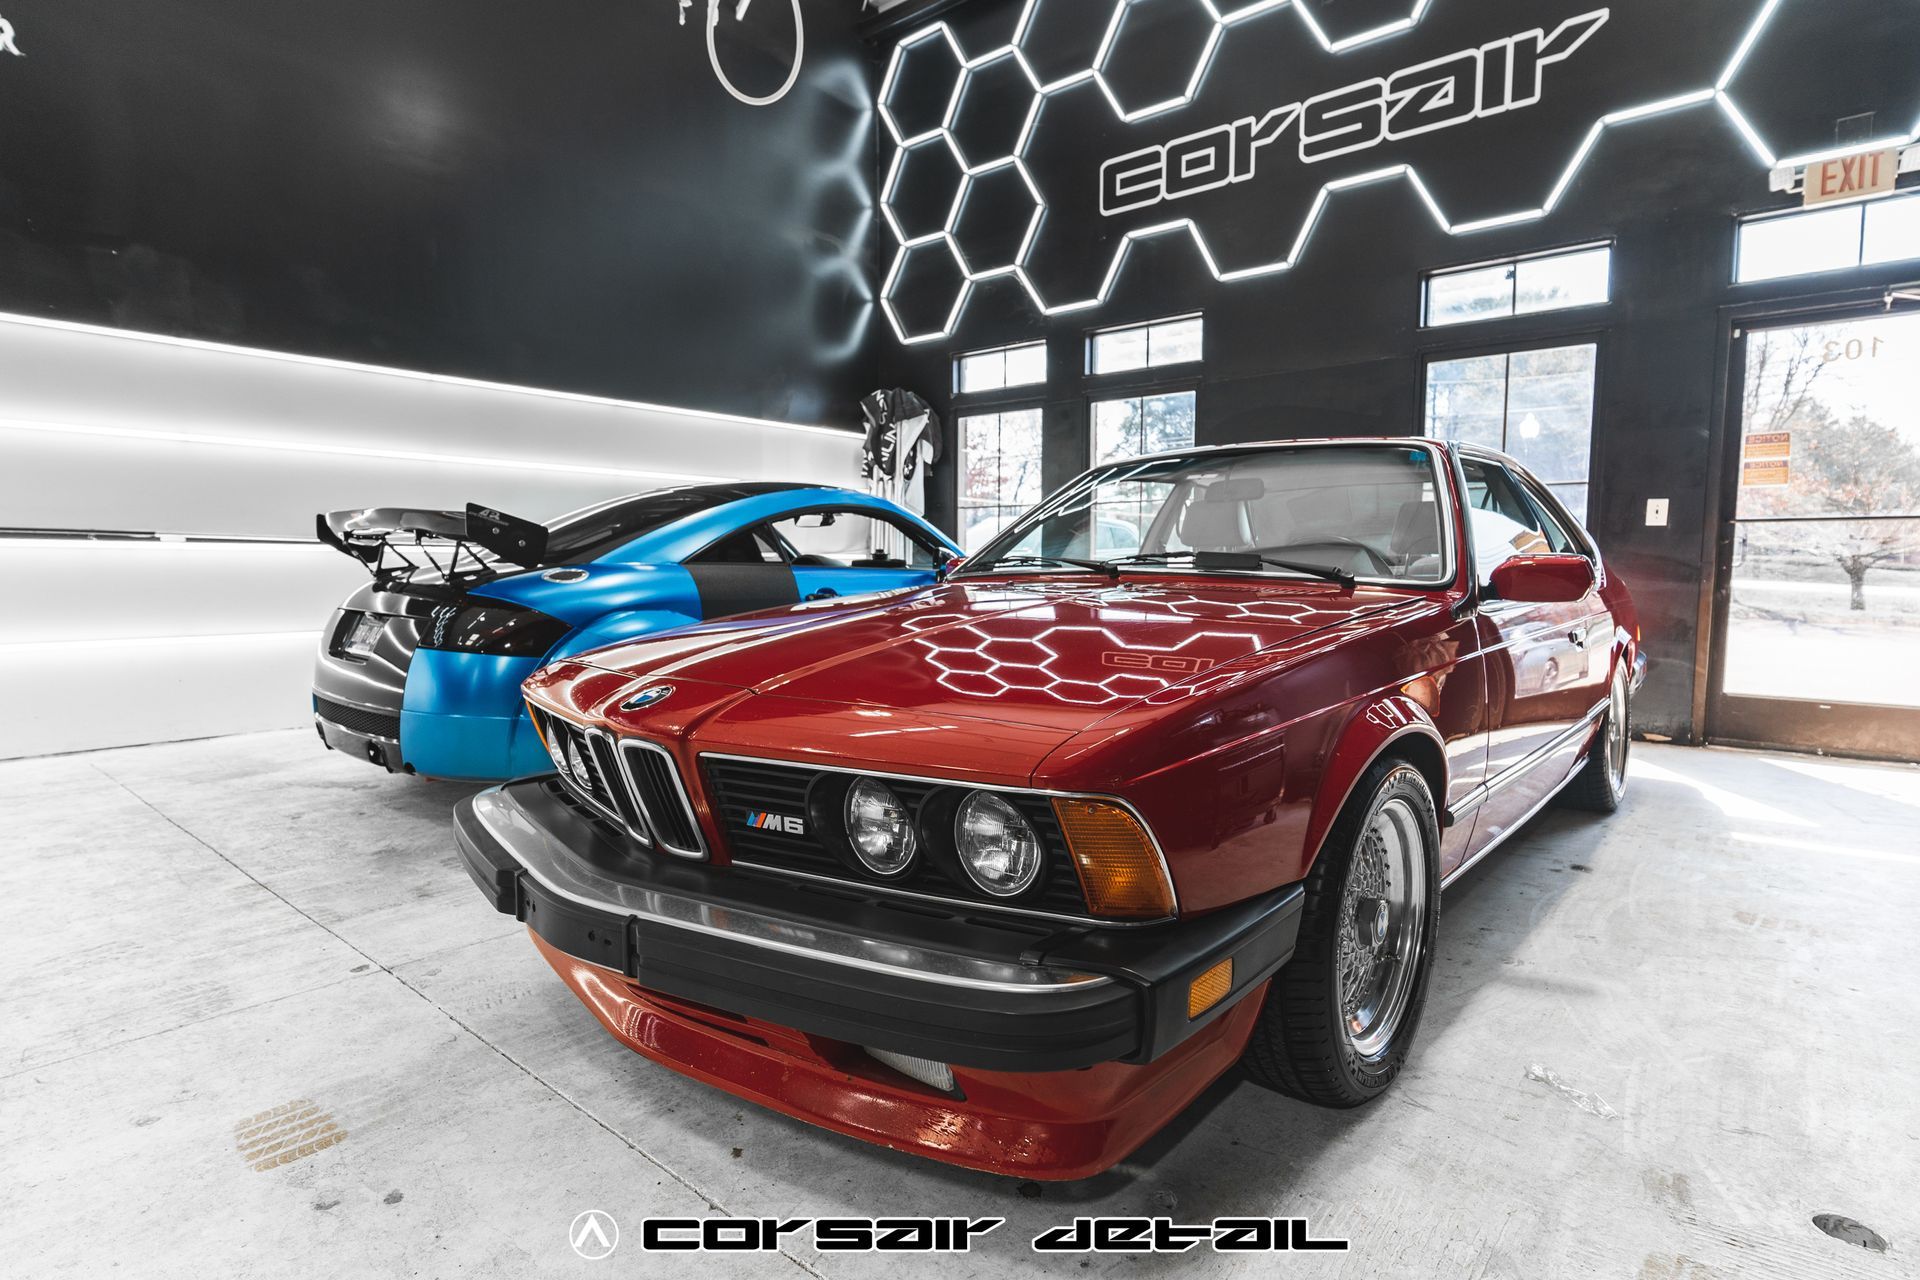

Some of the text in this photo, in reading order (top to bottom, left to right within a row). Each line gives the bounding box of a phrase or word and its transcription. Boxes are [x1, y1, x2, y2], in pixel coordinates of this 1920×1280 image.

[1100, 8, 1609, 216] corsair
[1820, 151, 1884, 197] EXIT
[763, 813, 804, 835] M6
